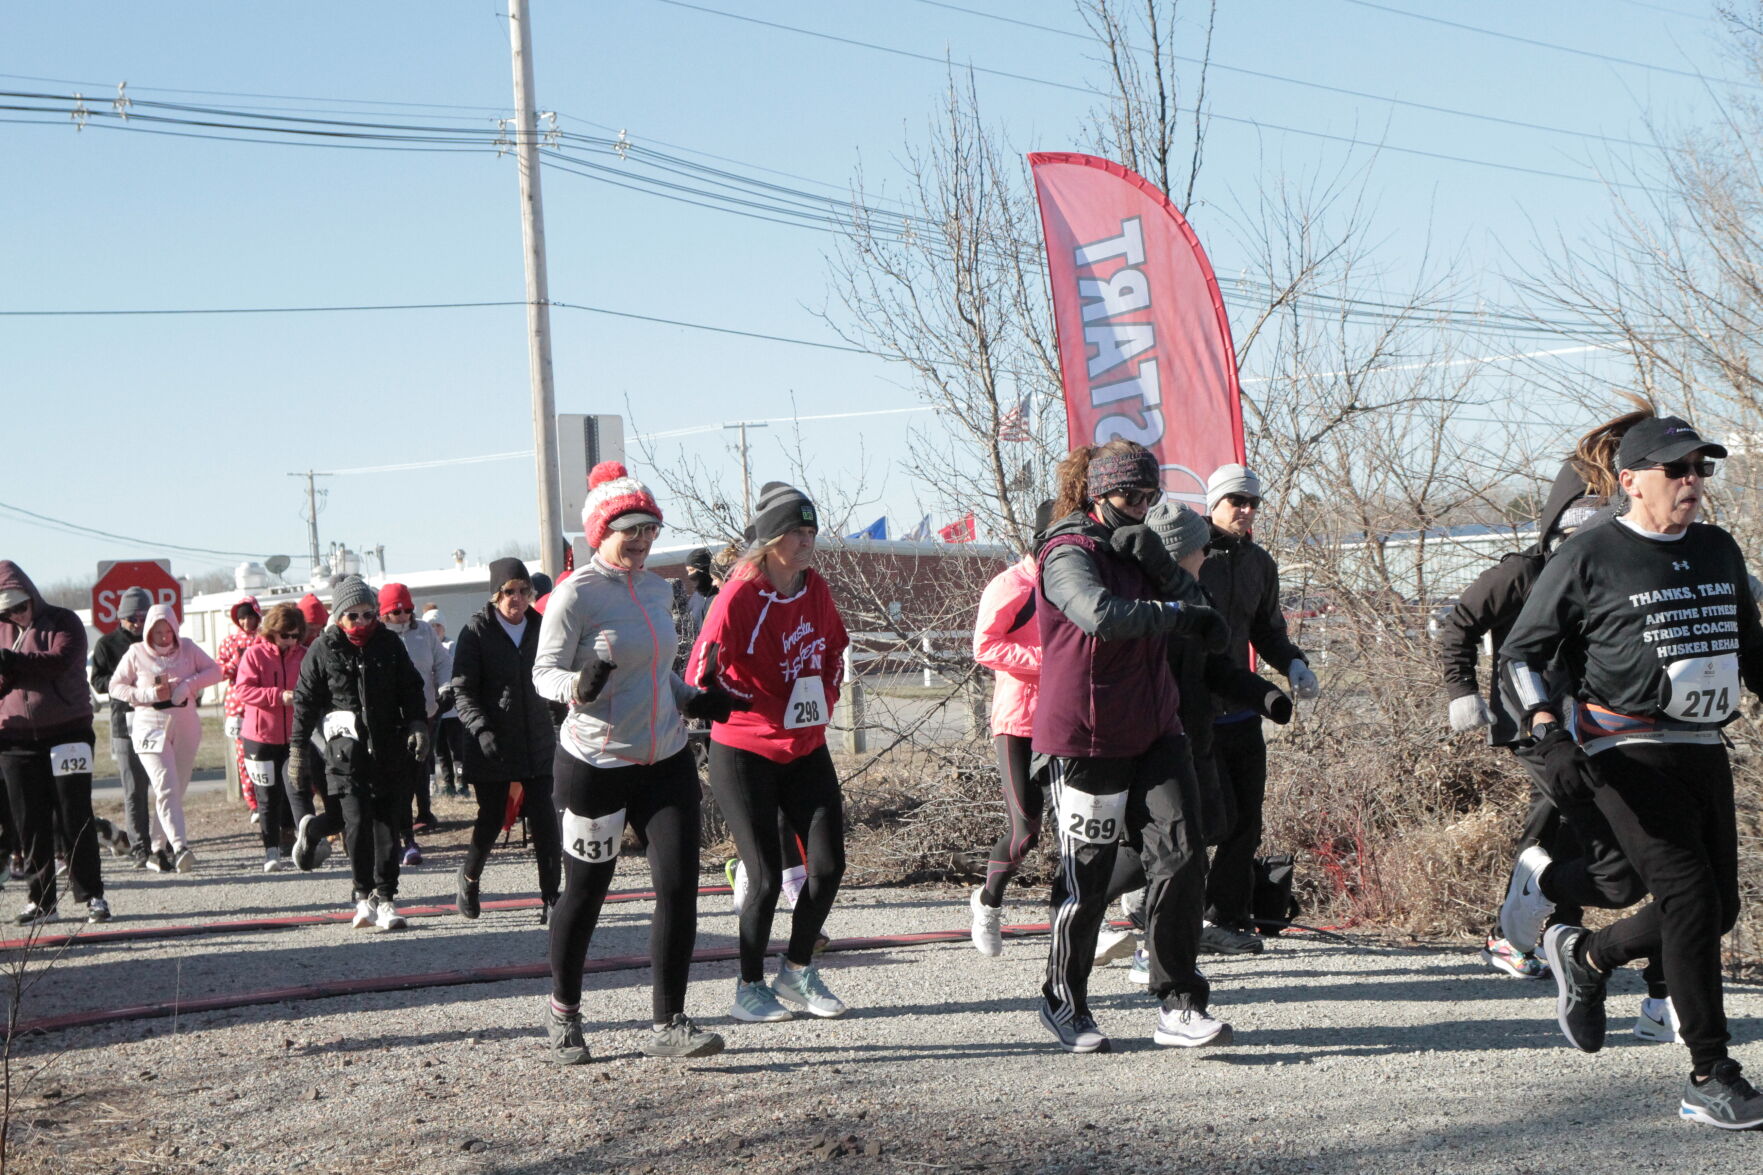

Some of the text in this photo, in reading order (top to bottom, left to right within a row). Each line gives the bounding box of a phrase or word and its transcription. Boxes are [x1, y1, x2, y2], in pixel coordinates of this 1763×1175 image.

[98, 587, 177, 623] SP
[1629, 586, 1697, 608] THANKS,
[1645, 607, 1700, 626] ANYTIME
[1643, 625, 1690, 643] STRIDE
[1656, 641, 1709, 658] HUSKER
[793, 700, 820, 723] 298
[1680, 687, 1729, 717] 274
[61, 757, 87, 772] 432
[1069, 813, 1116, 840] 269
[572, 836, 614, 860] 431
